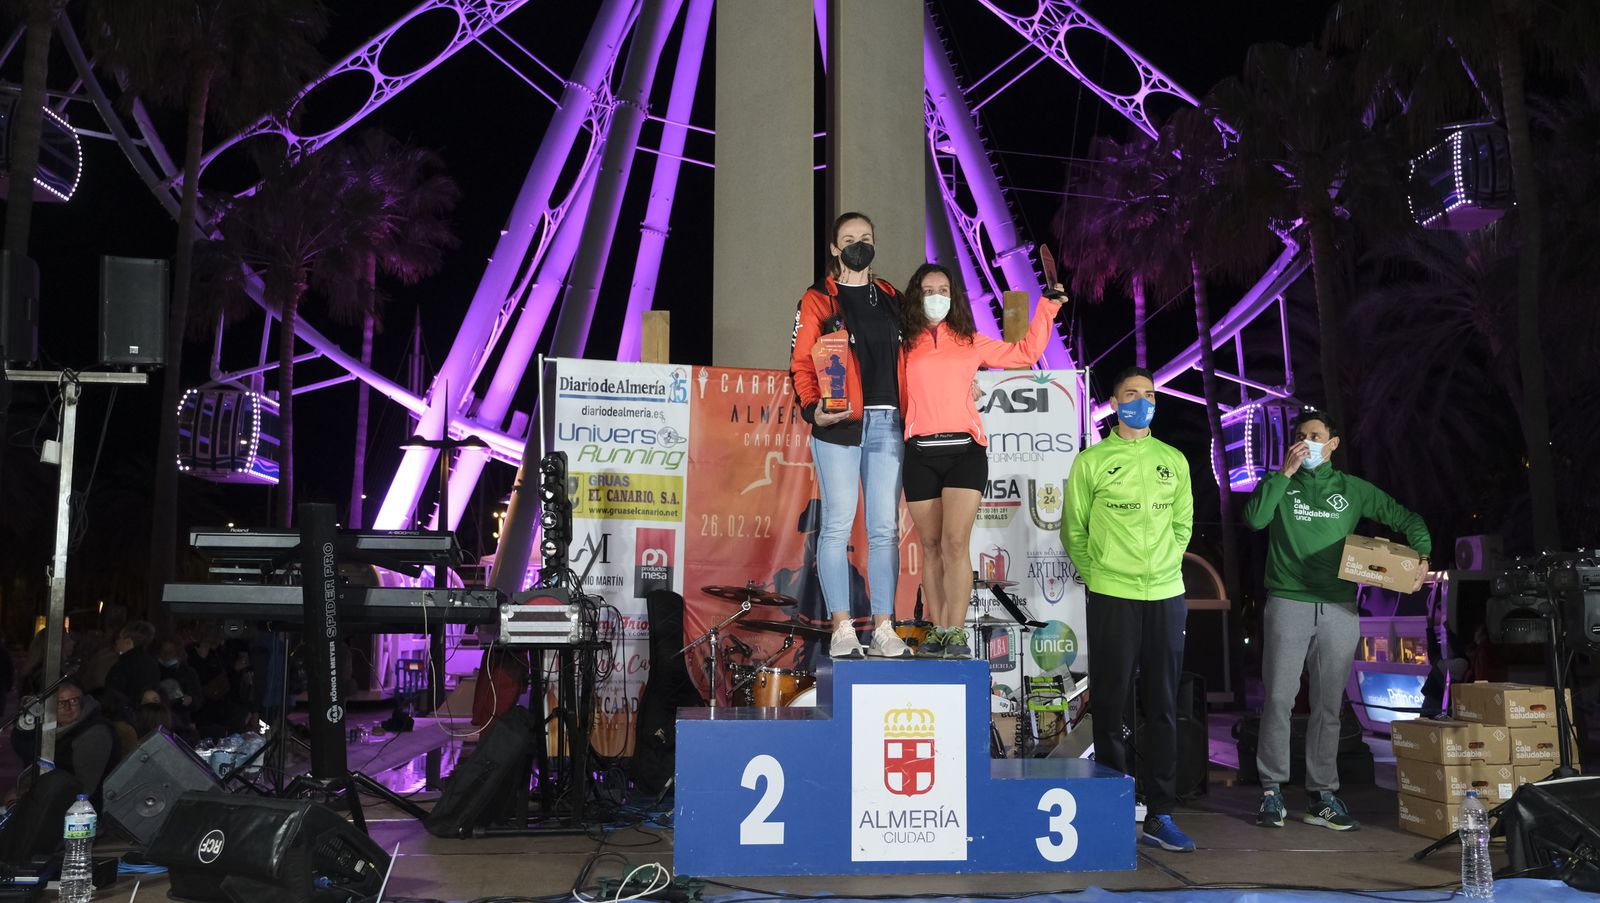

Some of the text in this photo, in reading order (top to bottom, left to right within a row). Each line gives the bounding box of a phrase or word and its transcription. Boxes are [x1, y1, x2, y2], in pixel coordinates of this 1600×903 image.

[559, 376, 666, 395] Diario de Almería
[582, 406, 664, 419] diariodealmeria.es
[577, 444, 686, 470] Running
[588, 475, 630, 487] GRUAS
[588, 489, 602, 502] EL
[660, 492, 680, 505] S.A.
[1043, 495, 1056, 505] 24
[589, 507, 678, 517] www.gruaselcanario.net
[701, 514, 771, 538] 26.02.22
[323, 542, 335, 577] PRO
[596, 575, 624, 587] MARTÍN
[641, 571, 668, 580] mesa
[325, 579, 337, 639] SPIDER
[330, 676, 338, 702] KÖNIG
[739, 754, 785, 845] 2
[859, 805, 960, 829] ALMERÍA
[1035, 787, 1079, 863] 3
[200, 838, 223, 854] RCF
[883, 831, 936, 844] CIUDAD
